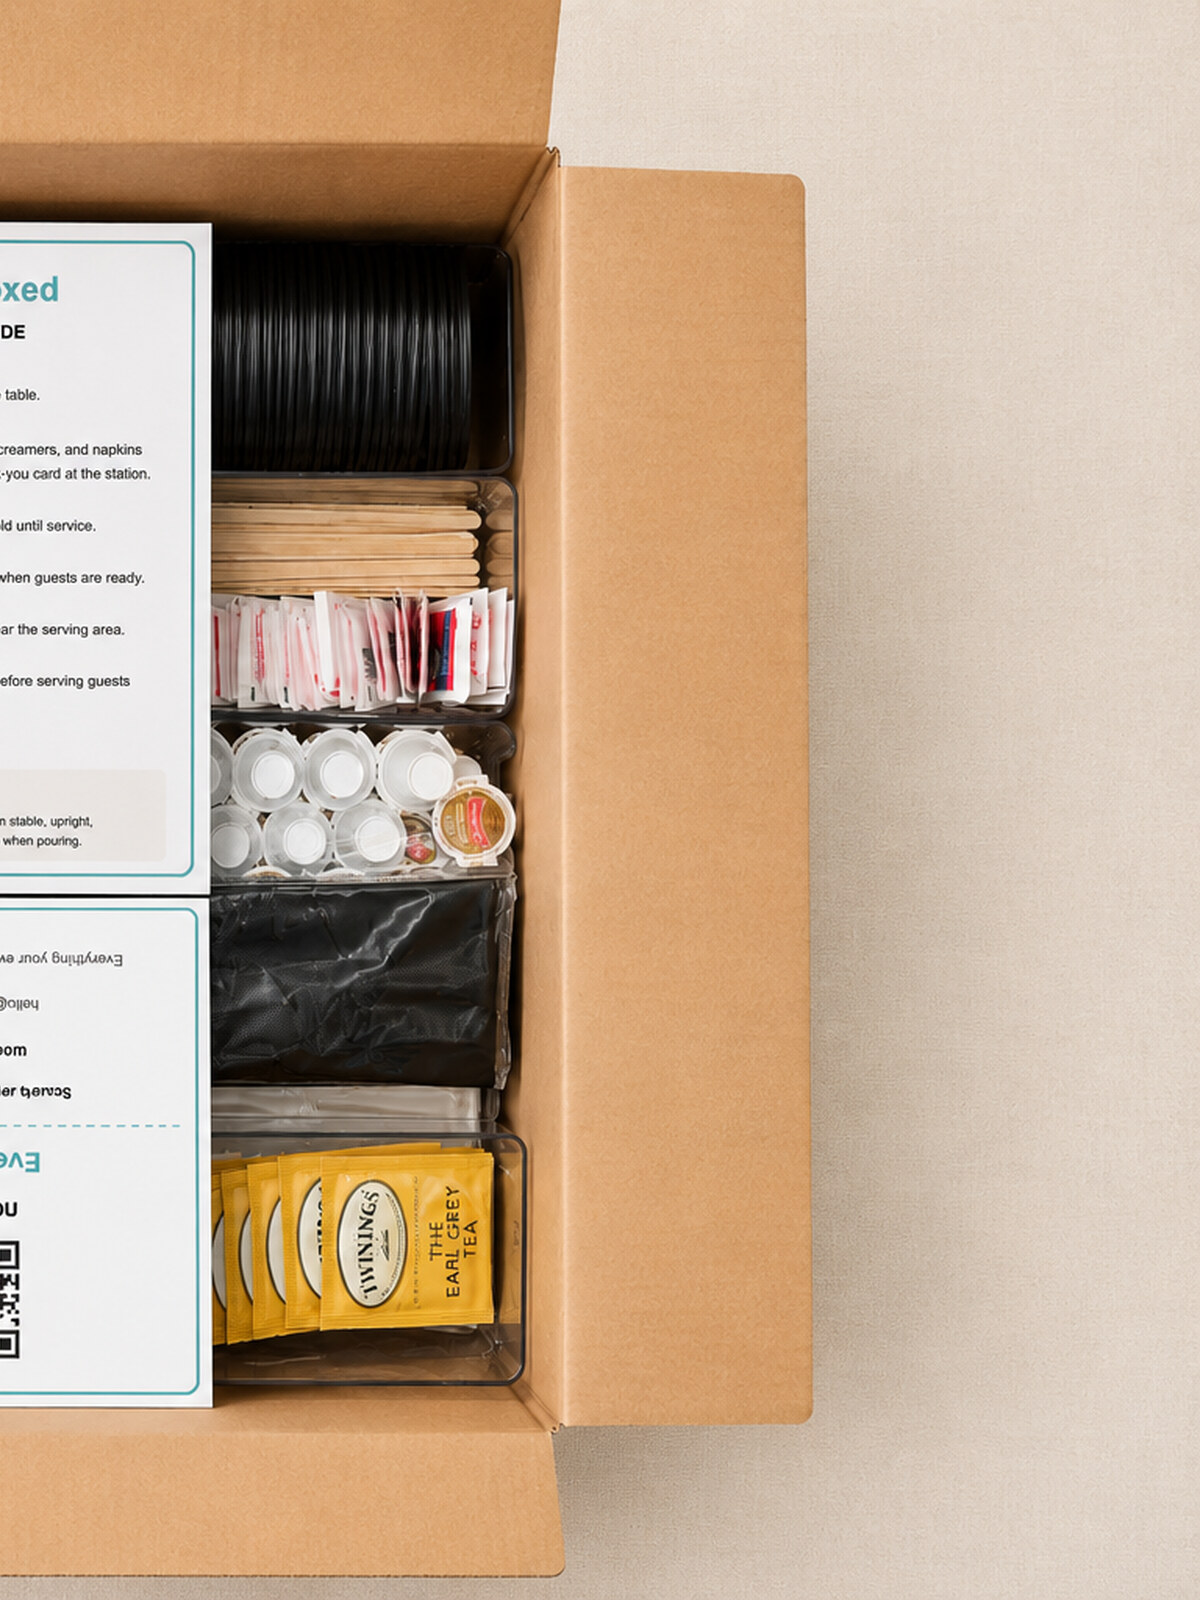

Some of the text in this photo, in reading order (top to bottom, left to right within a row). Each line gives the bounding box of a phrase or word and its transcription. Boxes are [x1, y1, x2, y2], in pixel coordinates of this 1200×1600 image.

[4, 388, 41, 401] table.
[64, 443, 89, 456] and
[92, 443, 143, 459] napkins
[32, 467, 62, 481] card
[64, 467, 78, 481] at
[80, 467, 102, 481] the
[104, 466, 151, 481] station.
[15, 519, 44, 533] until
[46, 519, 97, 533] service.
[33, 572, 78, 587] guests
[80, 573, 103, 584] are
[105, 571, 145, 587] ready.
[17, 622, 39, 636] the
[41, 622, 89, 639] serving
[91, 625, 126, 636] area.
[36, 674, 84, 690] serving
[86, 675, 131, 690] guests
[8, 815, 48, 828] stable,
[50, 815, 94, 830] upright,
[2, 834, 34, 847] when
[36, 835, 83, 850] pouring.
[17, 950, 48, 964] your
[51, 950, 123, 968] Everything
[357, 1190, 380, 1299] TWININGS
[428, 1221, 444, 1261] THE
[463, 1219, 478, 1259] TEA
[445, 1249, 460, 1298] EARL
